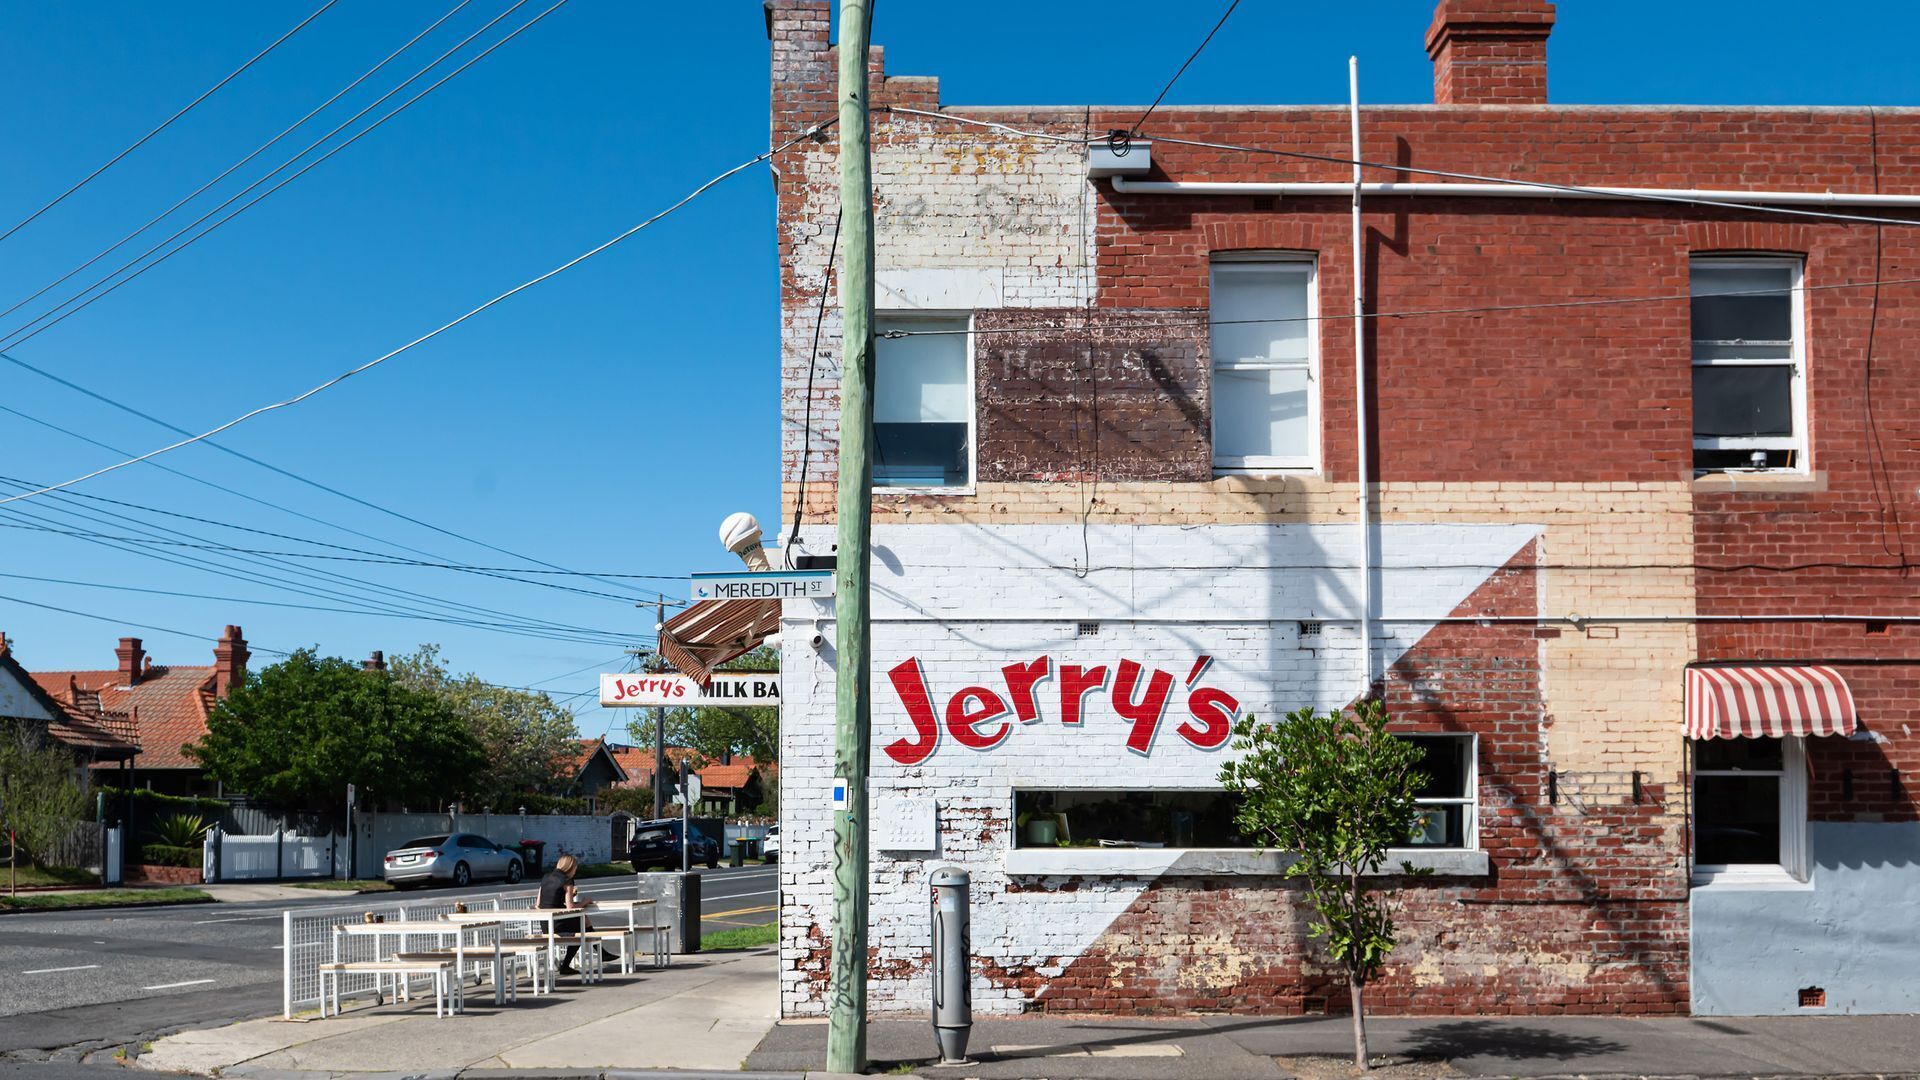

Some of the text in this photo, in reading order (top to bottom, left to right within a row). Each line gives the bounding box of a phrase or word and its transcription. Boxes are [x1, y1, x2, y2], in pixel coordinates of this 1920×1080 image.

[715, 581, 822, 598] MEREDITH ST
[614, 679, 780, 700] Jerry's MILK BA
[883, 655, 1241, 765] Jerry's
